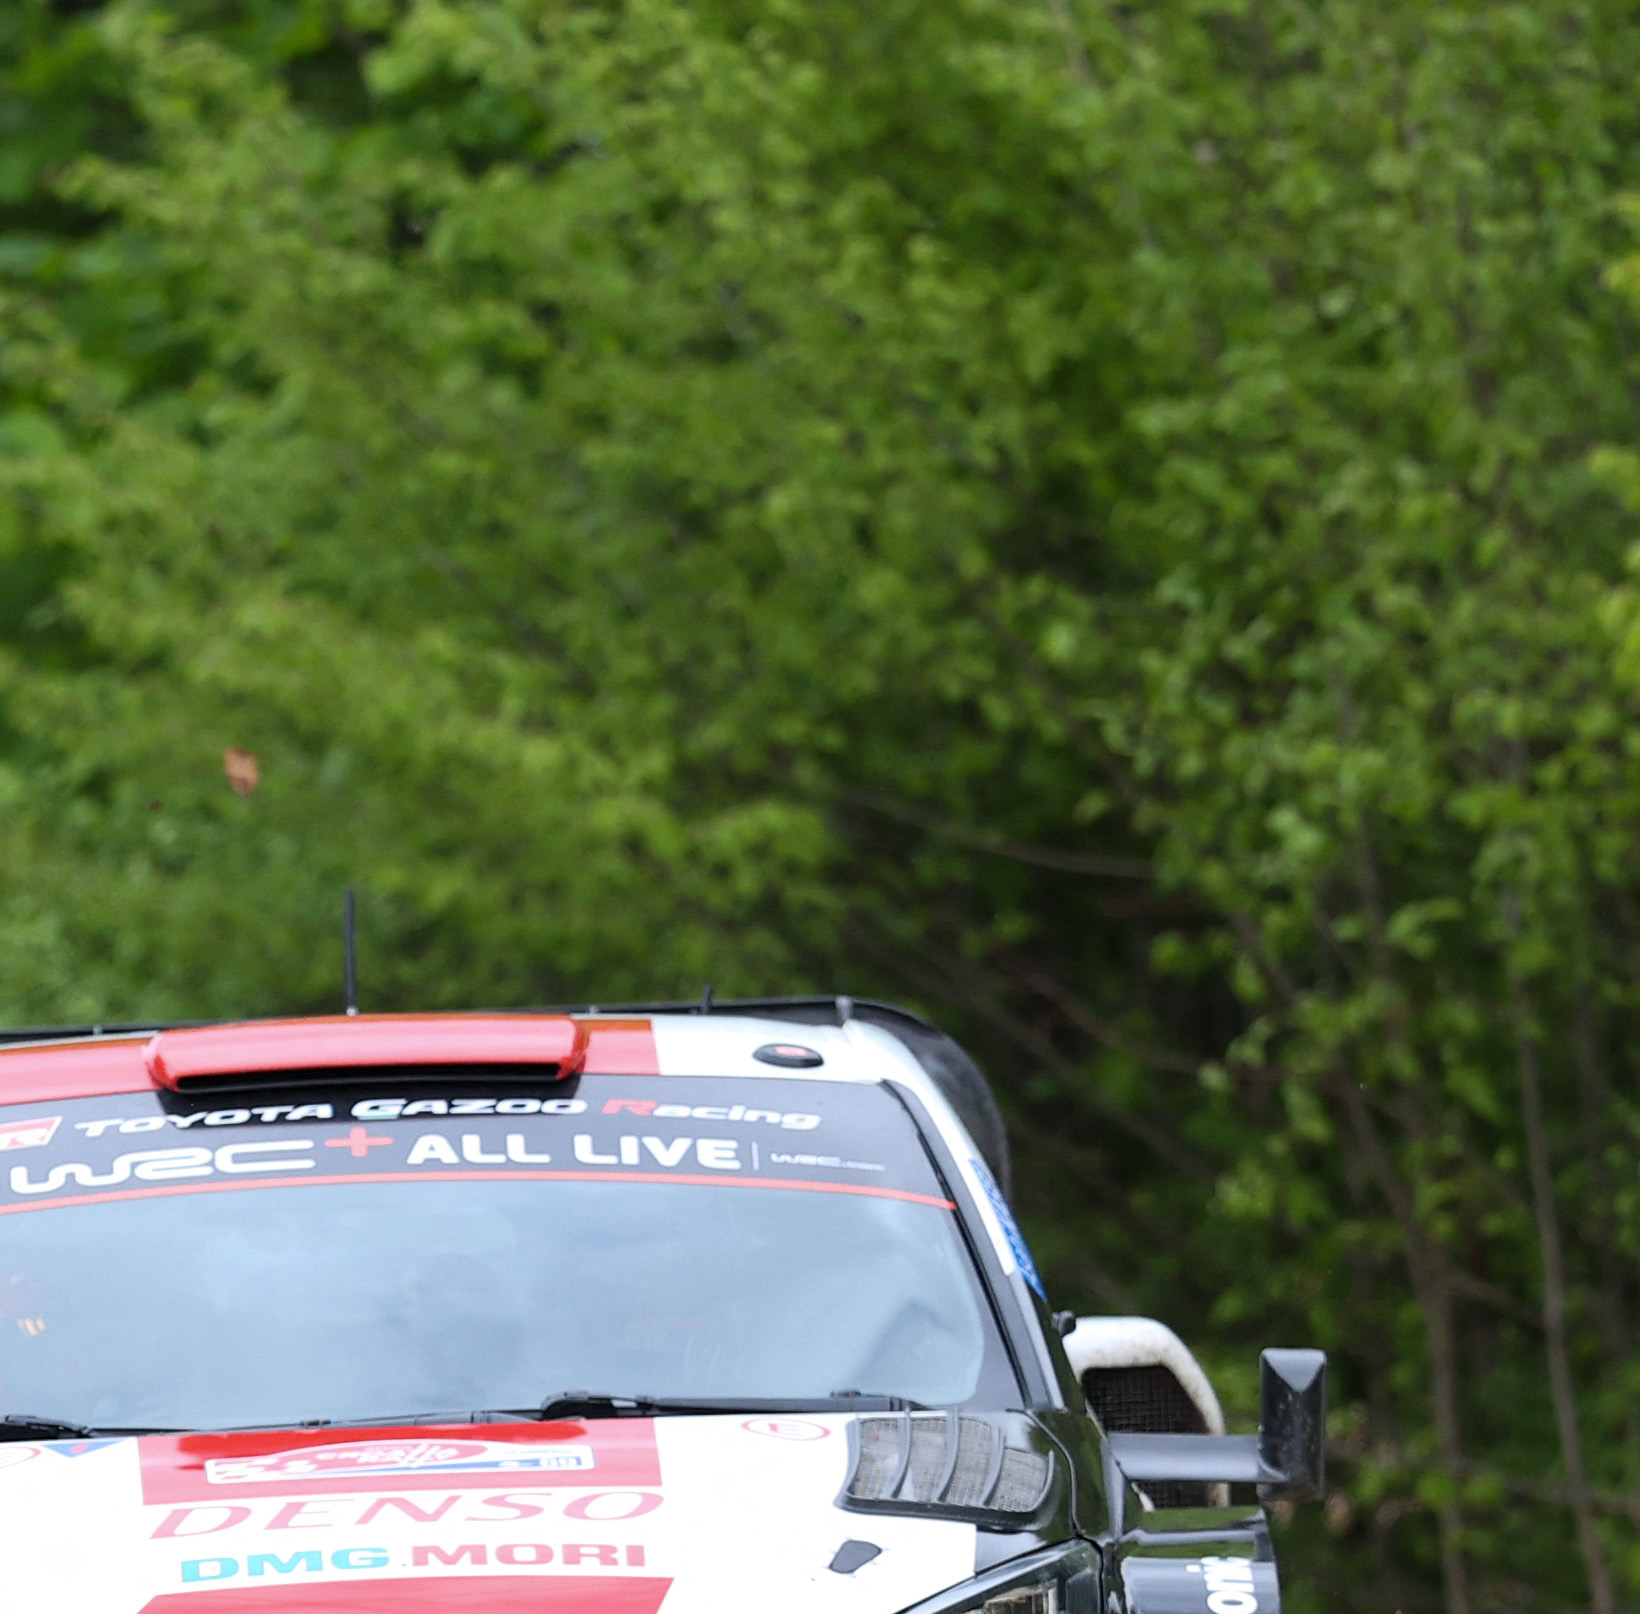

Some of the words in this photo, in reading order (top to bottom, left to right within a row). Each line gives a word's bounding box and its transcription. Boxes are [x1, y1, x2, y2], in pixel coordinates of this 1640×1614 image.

[74, 1103, 334, 1137] TOYOTA
[350, 1098, 588, 1120] GAZOO
[601, 1098, 821, 1130] Racing
[406, 1133, 552, 1165] ALL
[573, 1133, 742, 1171] LIVE
[148, 1491, 665, 1539] DENSO
[180, 1546, 391, 1583] DMG
[411, 1543, 646, 1568] MORI
